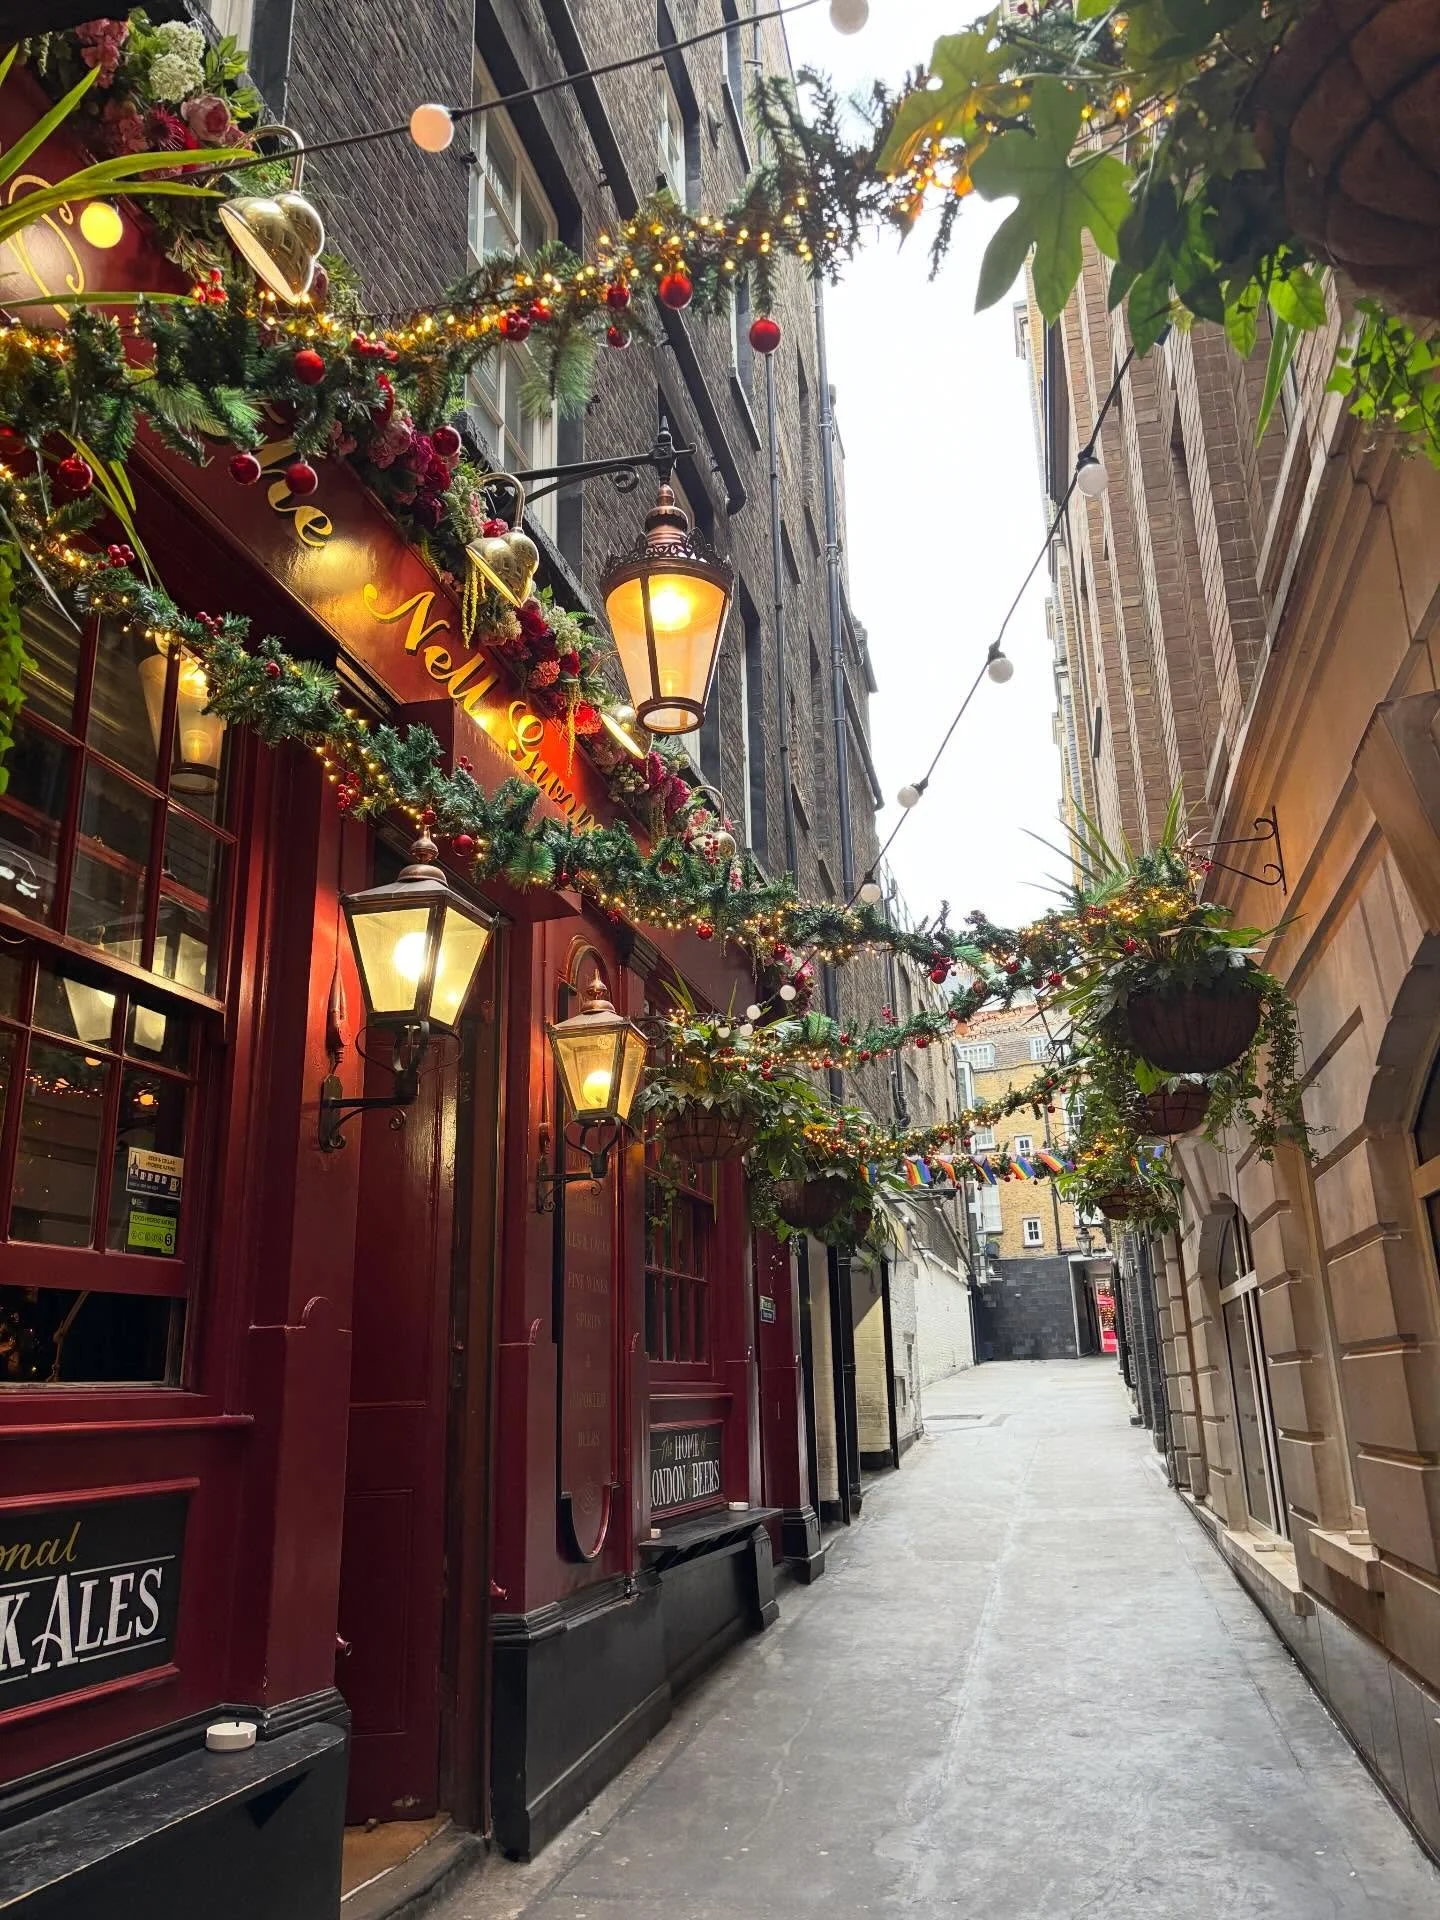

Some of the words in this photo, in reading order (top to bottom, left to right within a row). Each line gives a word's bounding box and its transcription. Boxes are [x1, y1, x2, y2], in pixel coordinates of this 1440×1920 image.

[363, 583, 499, 716] Nell
[650, 1464, 687, 1508] ONDON
[691, 1459, 721, 1498] BEERS
[661, 1437, 673, 1462] The
[674, 1433, 700, 1461] HOME
[31, 1567, 163, 1675] ALES
